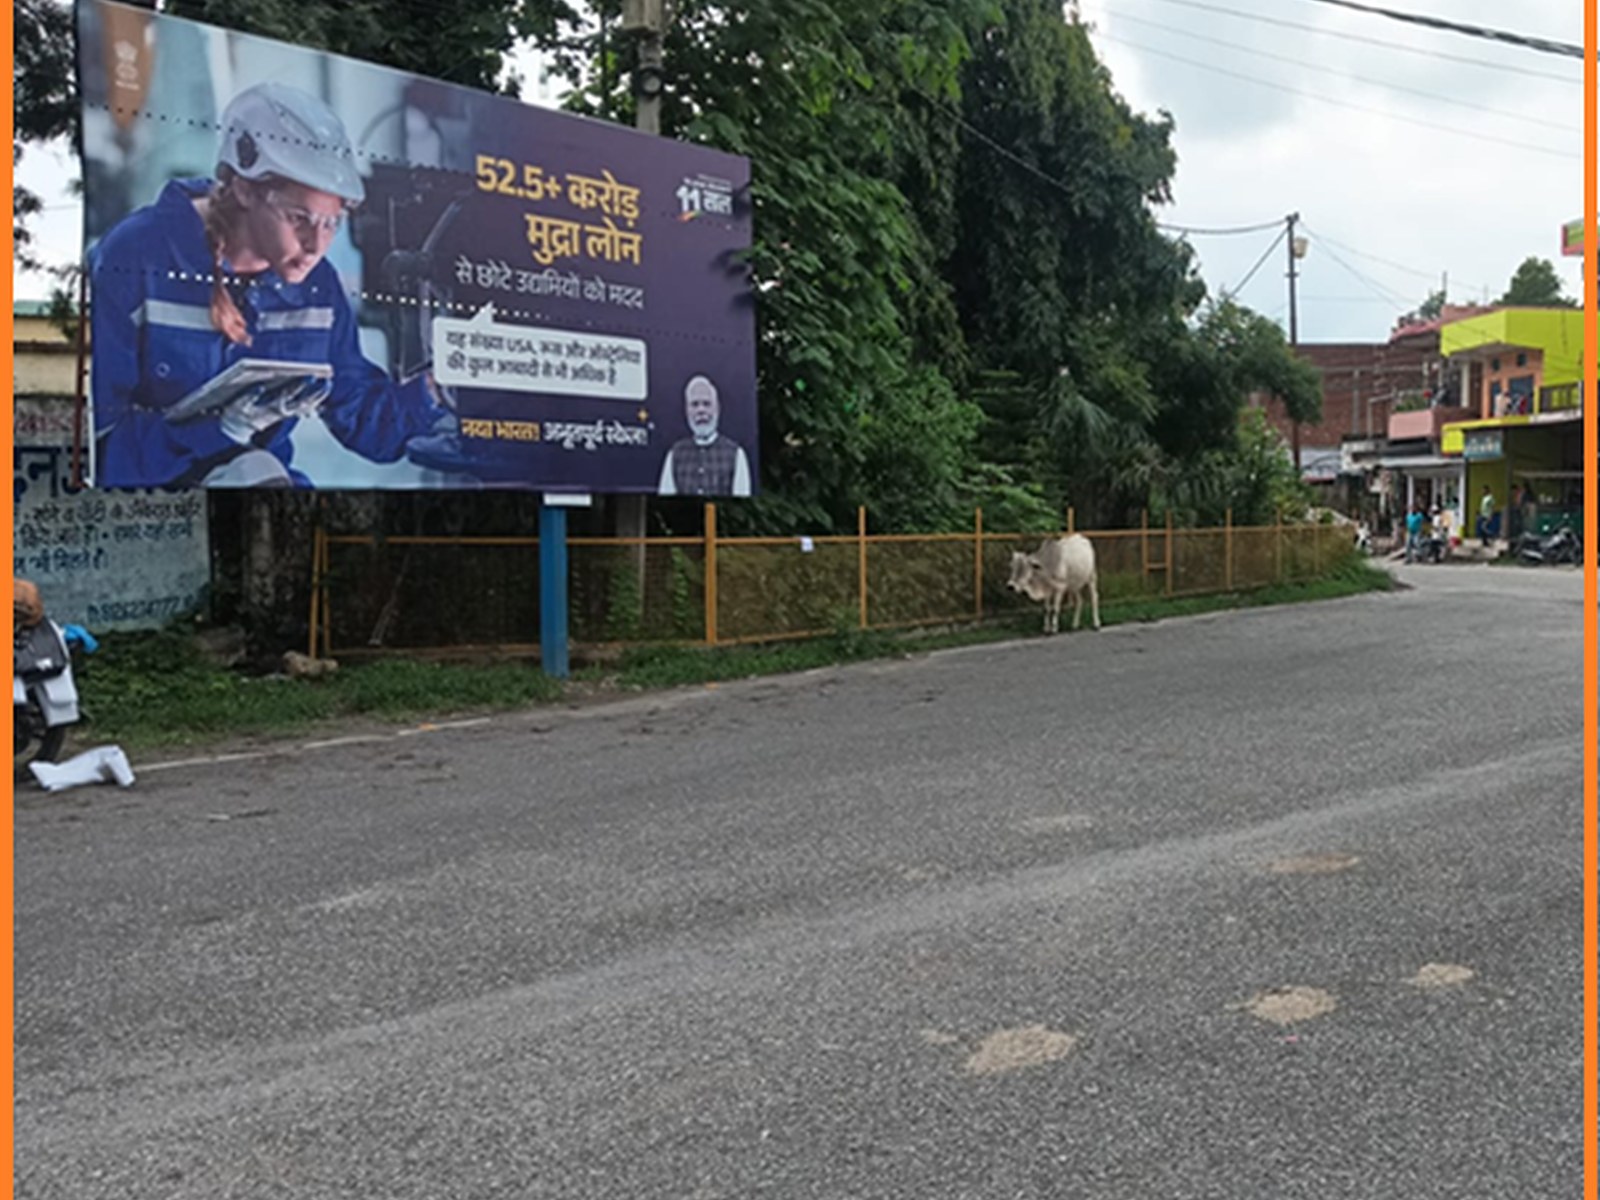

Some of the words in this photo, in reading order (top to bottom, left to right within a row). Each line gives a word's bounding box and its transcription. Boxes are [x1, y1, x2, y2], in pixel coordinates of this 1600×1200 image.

[476, 155, 561, 200] 52.5+
[565, 169, 640, 228] करोड़
[676, 185, 700, 213] 11
[524, 213, 580, 264] मुद्रा
[585, 217, 642, 264] लोन
[455, 255, 473, 284] से
[476, 259, 512, 290] छोटे
[584, 275, 606, 301] को
[609, 284, 644, 309] मदद
